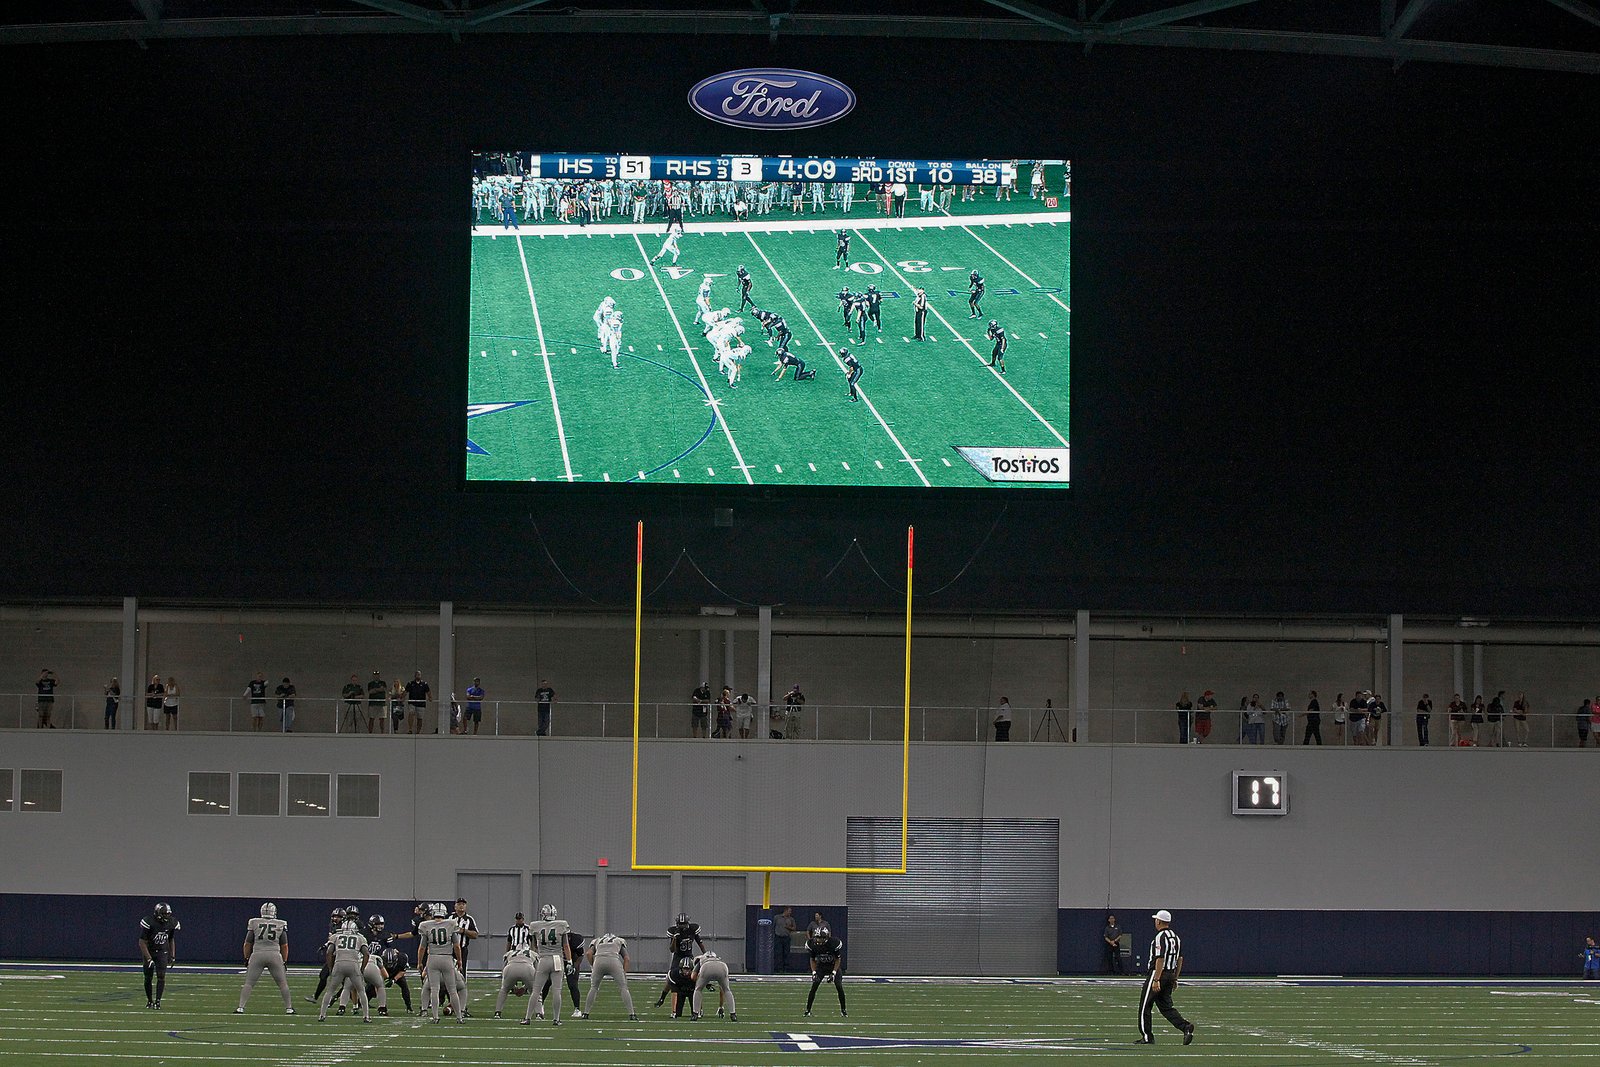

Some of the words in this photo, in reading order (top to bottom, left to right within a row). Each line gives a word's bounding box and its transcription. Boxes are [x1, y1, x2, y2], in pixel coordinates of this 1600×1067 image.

[721, 77, 822, 118] Ford
[558, 158, 593, 174] IHS
[605, 157, 617, 165] TO
[626, 160, 644, 174] 51
[666, 160, 712, 176] RHS
[741, 162, 751, 175] 3
[606, 165, 616, 177] 3
[717, 167, 728, 179] 3
[778, 159, 836, 179] 4:09
[851, 167, 883, 182] 3RD
[886, 168, 917, 182] 1ST
[928, 168, 953, 183] 10
[971, 169, 997, 184] 38
[1251, 777, 1280, 805] 17
[258, 923, 277, 940] 75
[430, 927, 448, 945] 10
[540, 928, 557, 945] 14
[337, 935, 358, 950] 30
